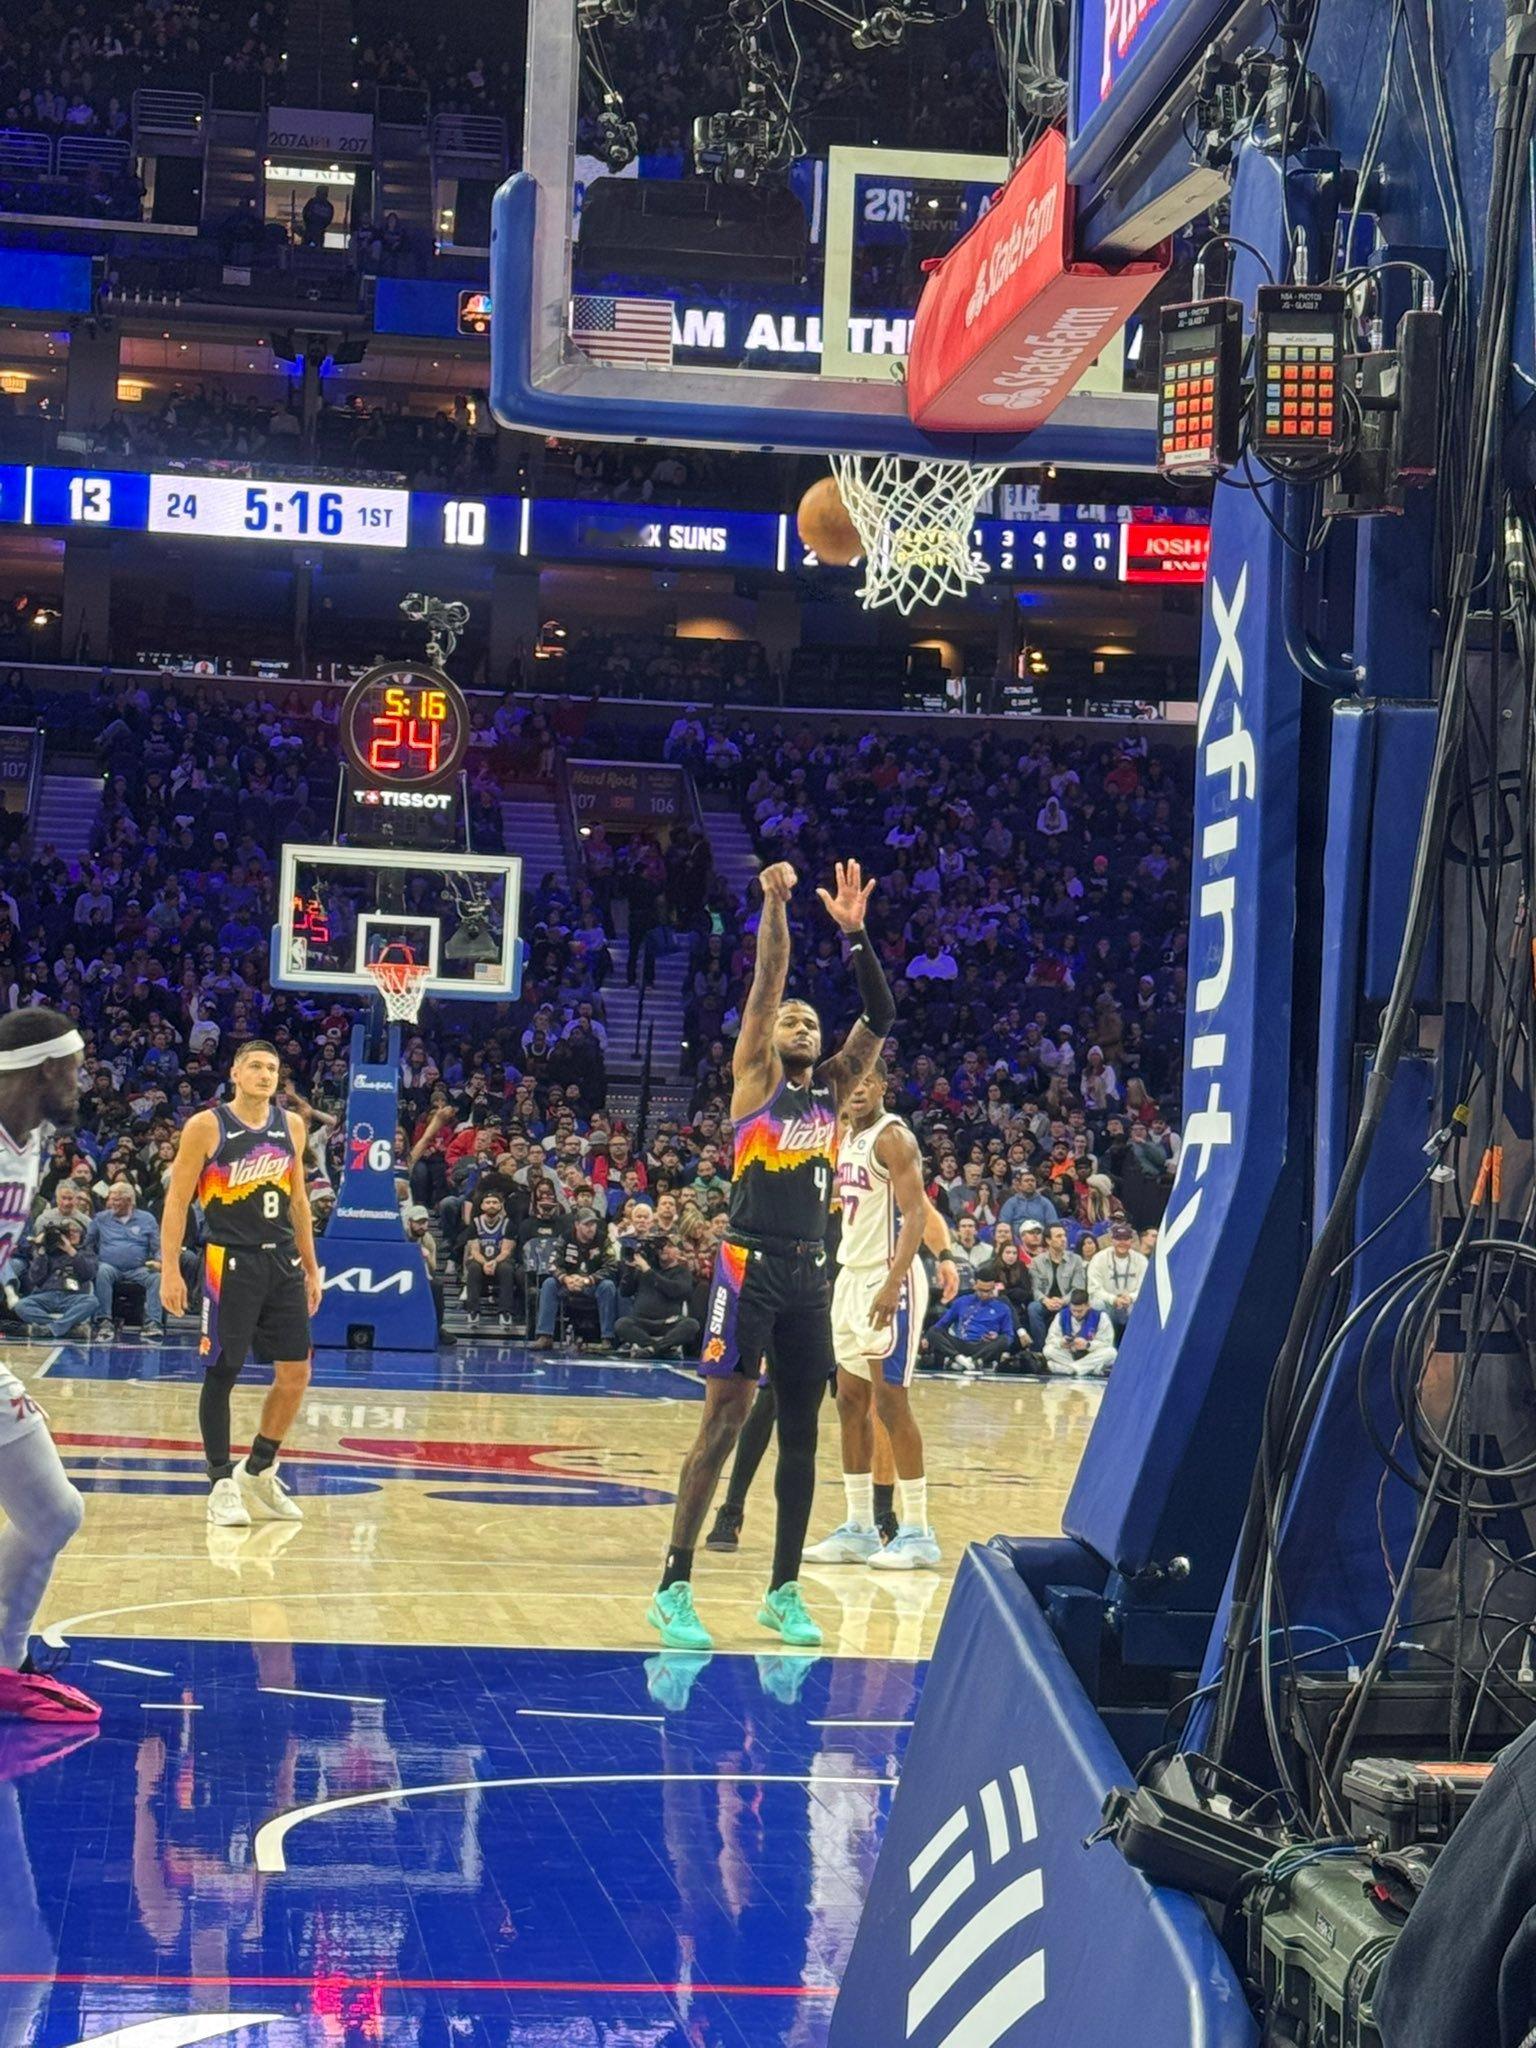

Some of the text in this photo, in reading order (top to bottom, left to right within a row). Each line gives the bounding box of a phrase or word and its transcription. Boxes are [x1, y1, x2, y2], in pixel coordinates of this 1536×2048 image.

[69, 478, 111, 521] 13
[167, 487, 393, 535] 24 5:16 1ST
[444, 501, 486, 545] 10
[669, 525, 727, 551] SUNS
[973, 529, 982, 546] 1
[1001, 530, 1014, 547] 3
[1033, 531, 1046, 548] 4
[1063, 532, 1077, 549] 8
[1093, 532, 1110, 549] 11
[1001, 553, 1013, 569] 2
[1034, 553, 1044, 570] 1
[1062, 553, 1076, 571] 0
[1094, 555, 1106, 571] 0
[1145, 537, 1201, 555] JOSH
[385, 688, 446, 720] 5:16
[370, 717, 440, 772] 24
[381, 790, 451, 809] TISSOT
[651, 798, 675, 814] 106
[1155, 560, 1255, 1330] xfinity
[227, 1152, 291, 1188] Valley
[351, 1139, 392, 1172] 76
[813, 1165, 827, 1202] 4
[263, 1190, 279, 1219] 8
[336, 1206, 399, 1220] ticketmaster
[709, 1285, 728, 1336] SUNS
